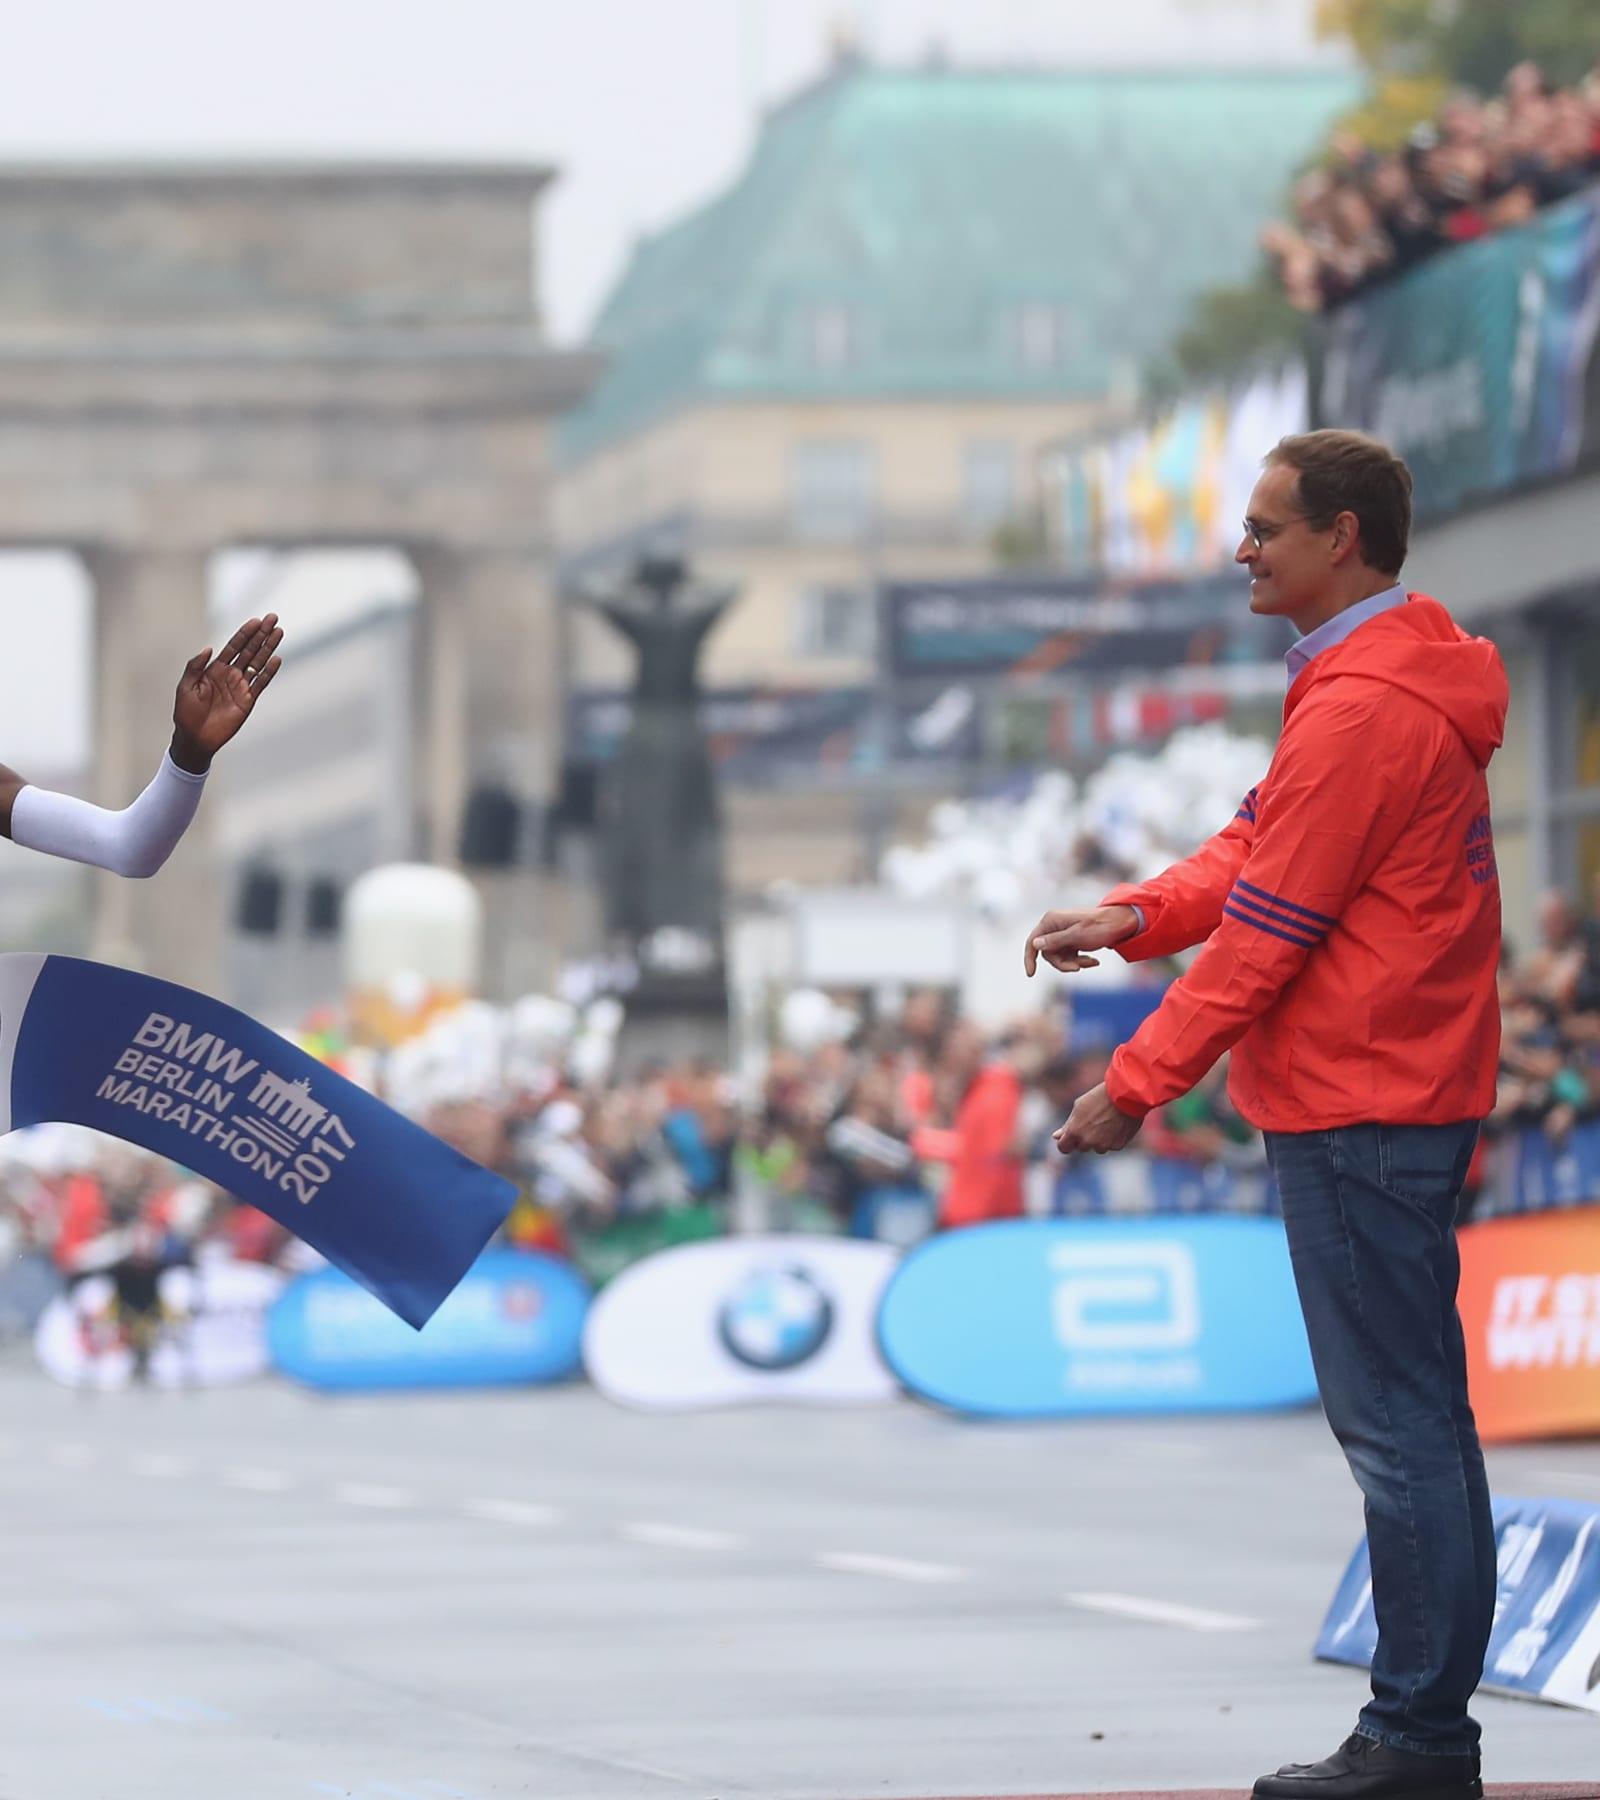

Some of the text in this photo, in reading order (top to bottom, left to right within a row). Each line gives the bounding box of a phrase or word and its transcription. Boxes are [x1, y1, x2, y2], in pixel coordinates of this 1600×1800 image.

[114, 1047, 235, 1114] BERLIN
[132, 1012, 260, 1085] BMW
[95, 1073, 285, 1181] MARATHON
[279, 1114, 356, 1205] 2017
